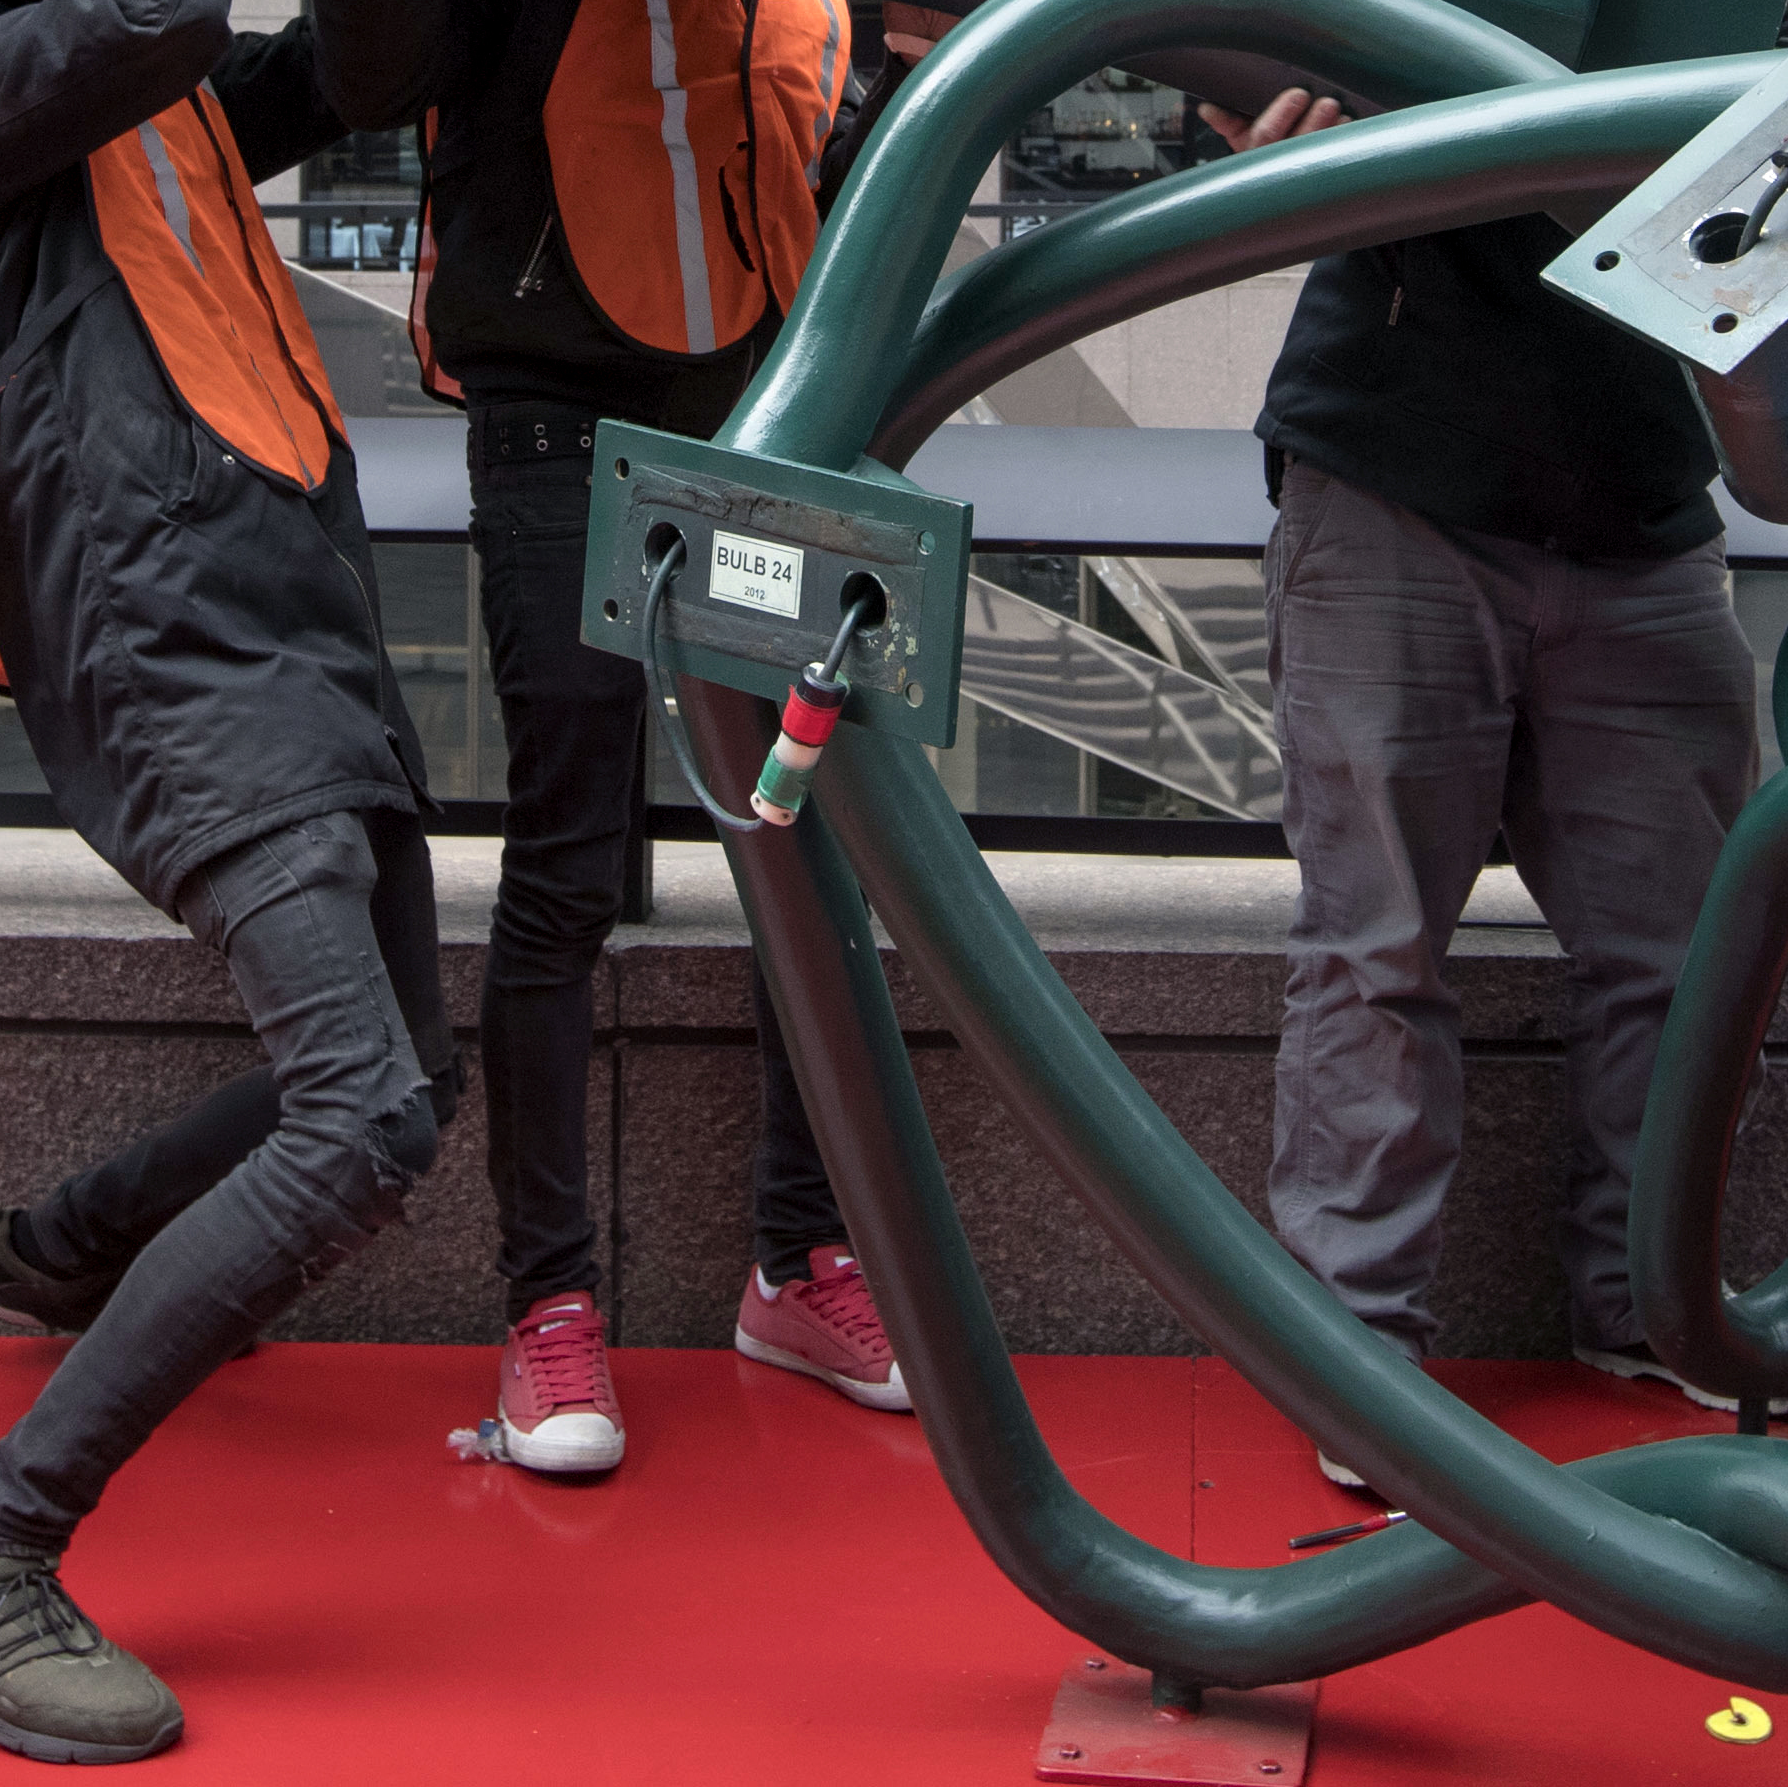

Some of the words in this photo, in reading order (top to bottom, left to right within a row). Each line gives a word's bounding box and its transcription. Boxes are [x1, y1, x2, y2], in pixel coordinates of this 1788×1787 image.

[717, 545, 767, 576] BULB
[771, 560, 792, 584] 24
[743, 585, 766, 602] 2012
